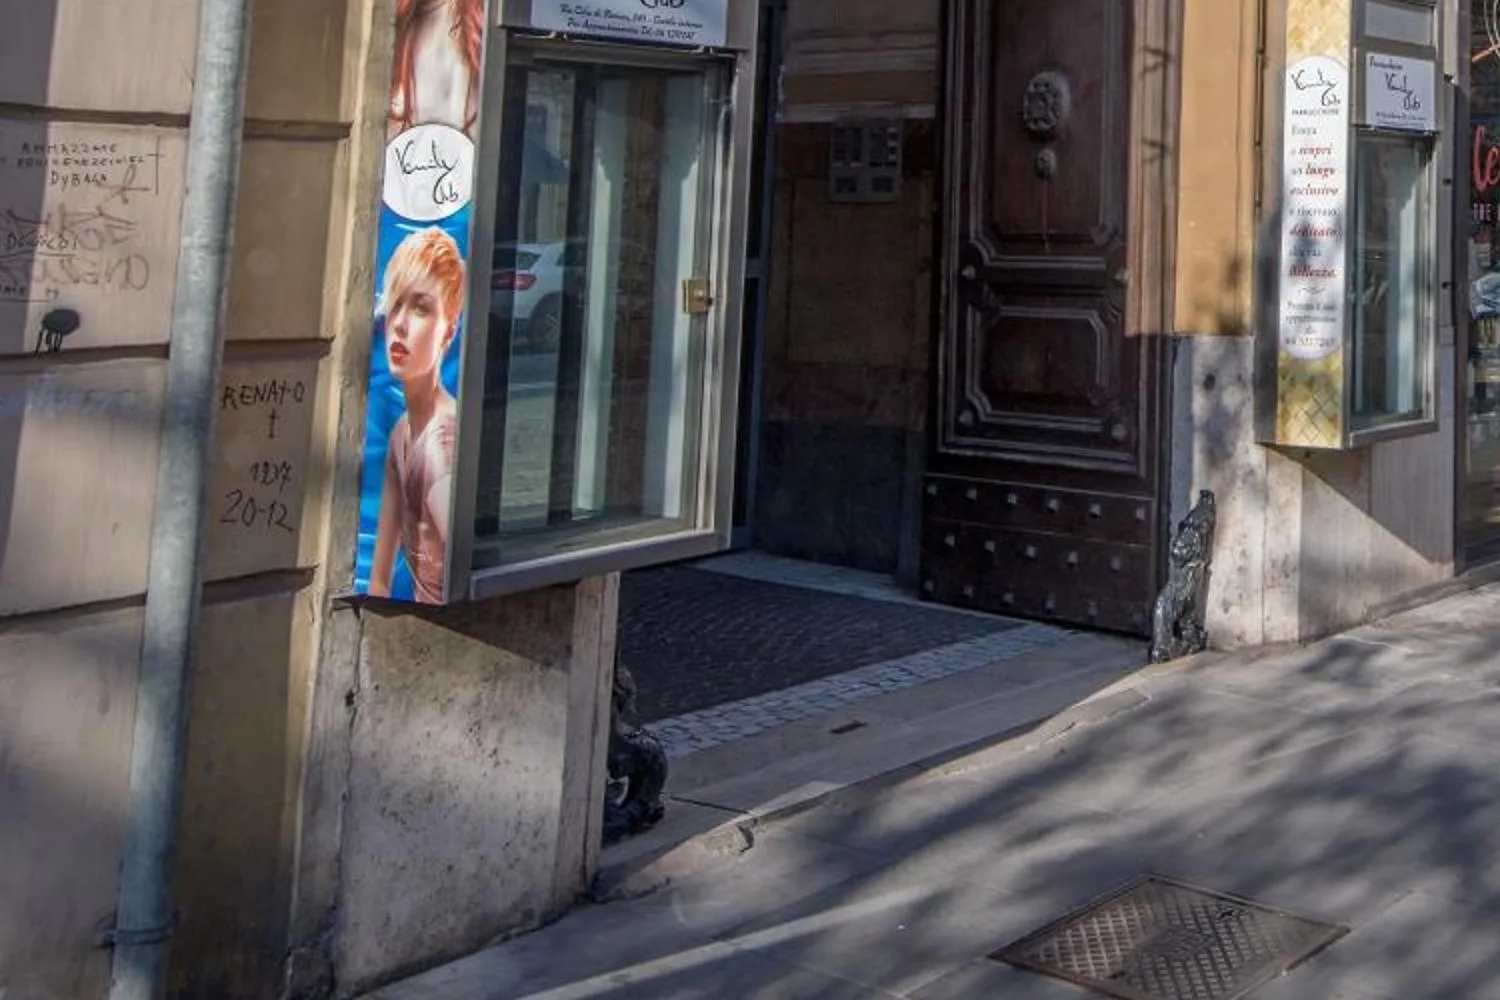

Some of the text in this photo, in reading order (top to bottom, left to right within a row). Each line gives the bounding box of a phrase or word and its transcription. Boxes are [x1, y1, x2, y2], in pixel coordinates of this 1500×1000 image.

[395, 138, 459, 176] Vanity
[1473, 202, 1493, 221] THE
[221, 378, 305, 410] RENATO
